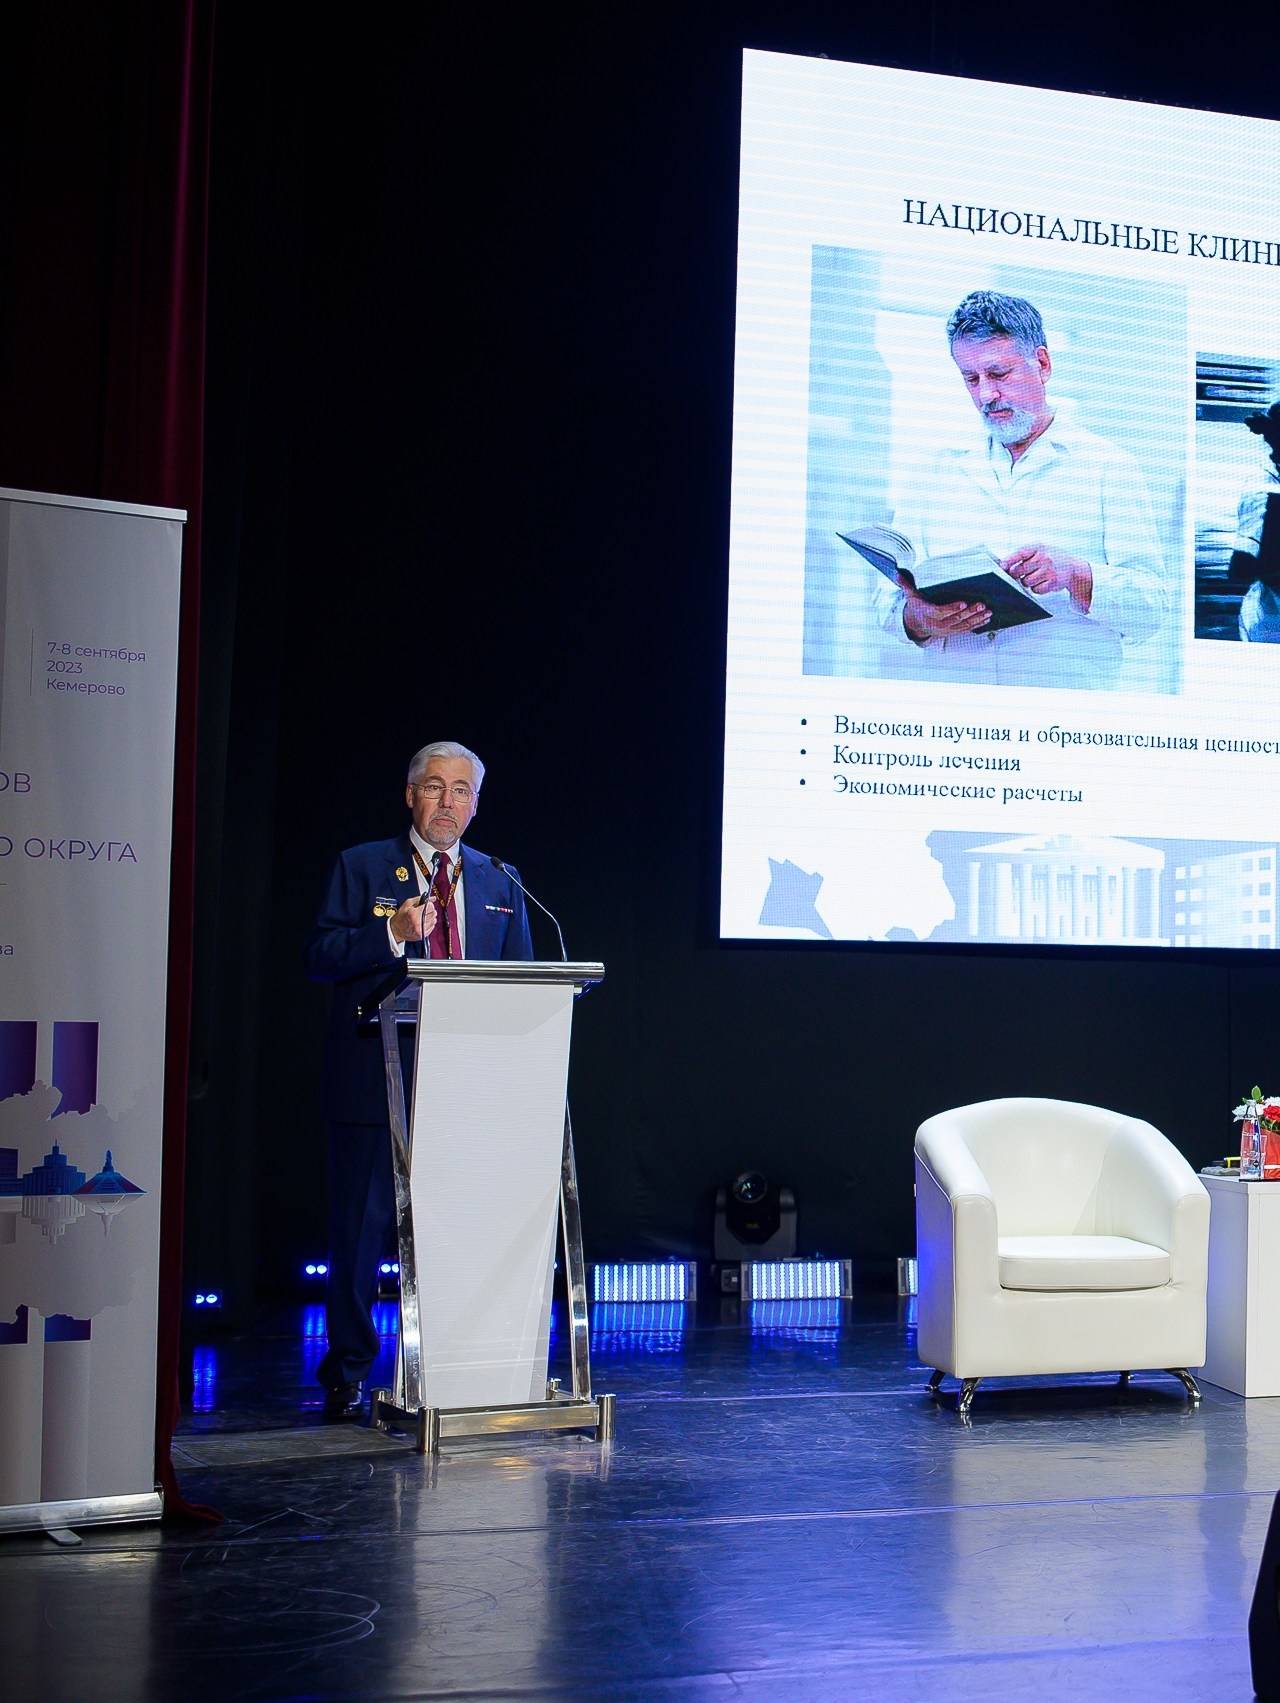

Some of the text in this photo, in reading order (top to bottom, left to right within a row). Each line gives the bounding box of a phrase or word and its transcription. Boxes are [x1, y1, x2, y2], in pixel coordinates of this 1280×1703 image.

[902, 198, 1180, 255] НАЦИОНАЛЬНЫЕ
[47, 641, 146, 664] 7-8 сентября
[46, 660, 83, 674] 2023
[46, 678, 125, 696] Кемерово
[834, 714, 923, 737] Высокая
[931, 725, 1011, 744] научная
[1018, 729, 1030, 742] и
[1037, 725, 1198, 751] образовательная
[833, 744, 1021, 772] Контроль лечения
[833, 774, 1082, 805] Экономические расчеты
[24, 837, 137, 863] ОКРУГА
